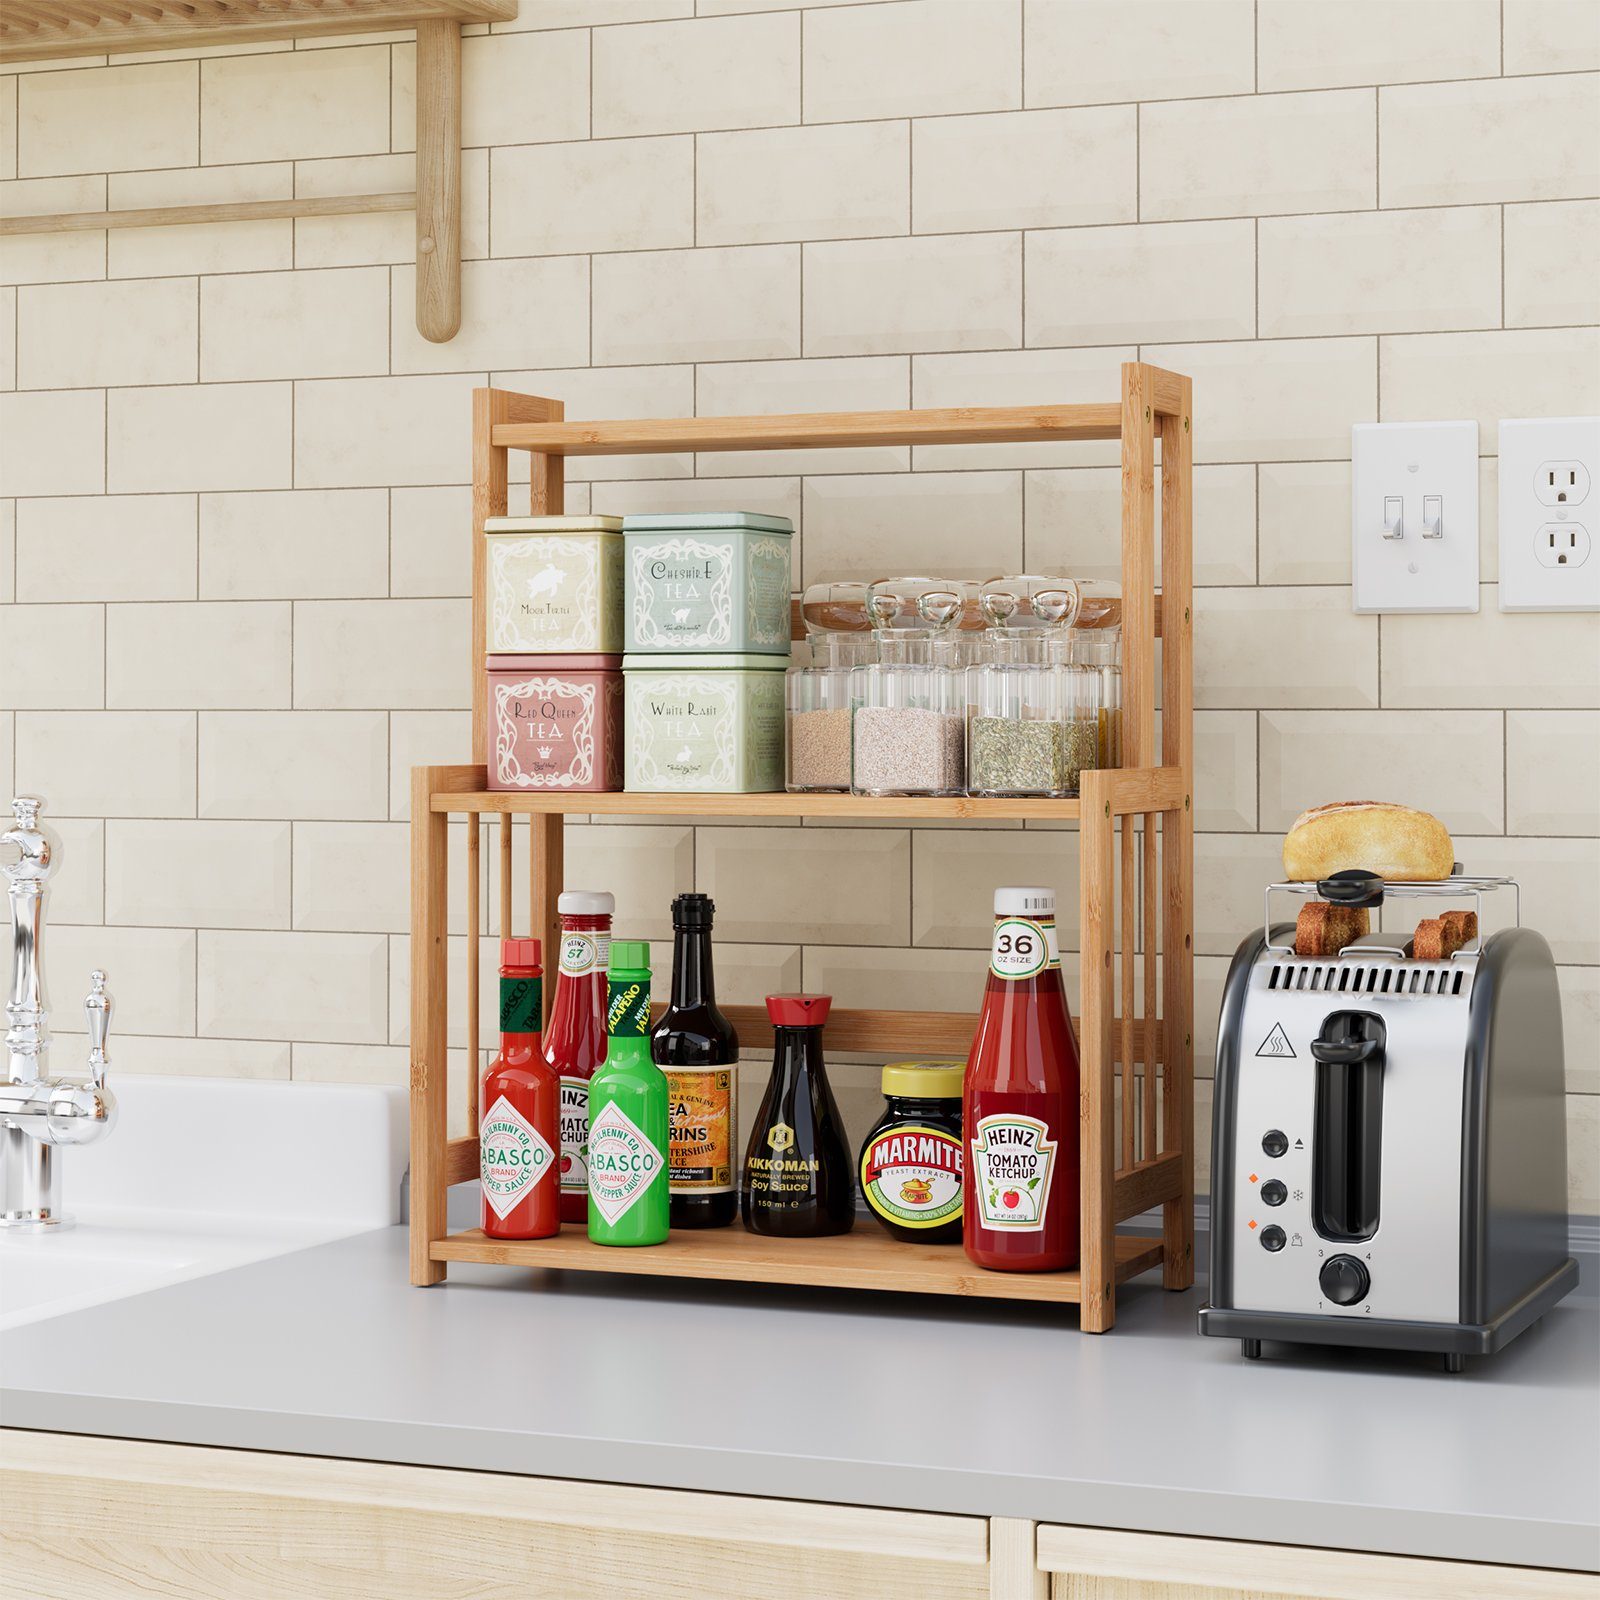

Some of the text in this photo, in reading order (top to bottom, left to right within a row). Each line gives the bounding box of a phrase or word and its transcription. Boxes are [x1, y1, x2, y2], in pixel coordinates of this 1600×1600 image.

[664, 583, 701, 599] TEA
[532, 618, 560, 631] TEA
[515, 701, 576, 720] RED QUEEN
[527, 722, 564, 739] TEA
[664, 721, 702, 737] TEA
[567, 940, 586, 949] HEINZ
[997, 935, 1033, 954] 36
[567, 949, 584, 959] 57
[561, 1090, 589, 1108] INZ
[686, 1095, 715, 1107] GENUINE
[669, 1103, 688, 1116] EA
[560, 1131, 589, 1143] CHUP
[669, 1127, 707, 1141] RINS
[988, 1128, 1035, 1147] HEINZ
[669, 1142, 717, 1156] TERSHIRE
[873, 1136, 963, 1173] MARMITE
[481, 1147, 545, 1166] ABASCO
[590, 1153, 654, 1172] ABASCO
[669, 1157, 687, 1166] UCE
[987, 1153, 1038, 1168] TOMATO
[748, 1157, 820, 1172] KIKKOMAN
[490, 1167, 517, 1176] BRAND
[599, 1174, 627, 1182] BRAND
[751, 1172, 780, 1180] NATURALLY
[886, 1168, 950, 1180] YEAST EXTRACT
[989, 1167, 1036, 1179] KETCHUP
[505, 1166, 532, 1192] SAUCE
[600, 1188, 624, 1199] PEPPER
[624, 1172, 642, 1194] SAUCE
[751, 1179, 809, 1192] Soy Sauce
[1318, 1249, 1324, 1257] 3
[1366, 1252, 1371, 1260] 4
[1365, 1305, 1371, 1314] 2
